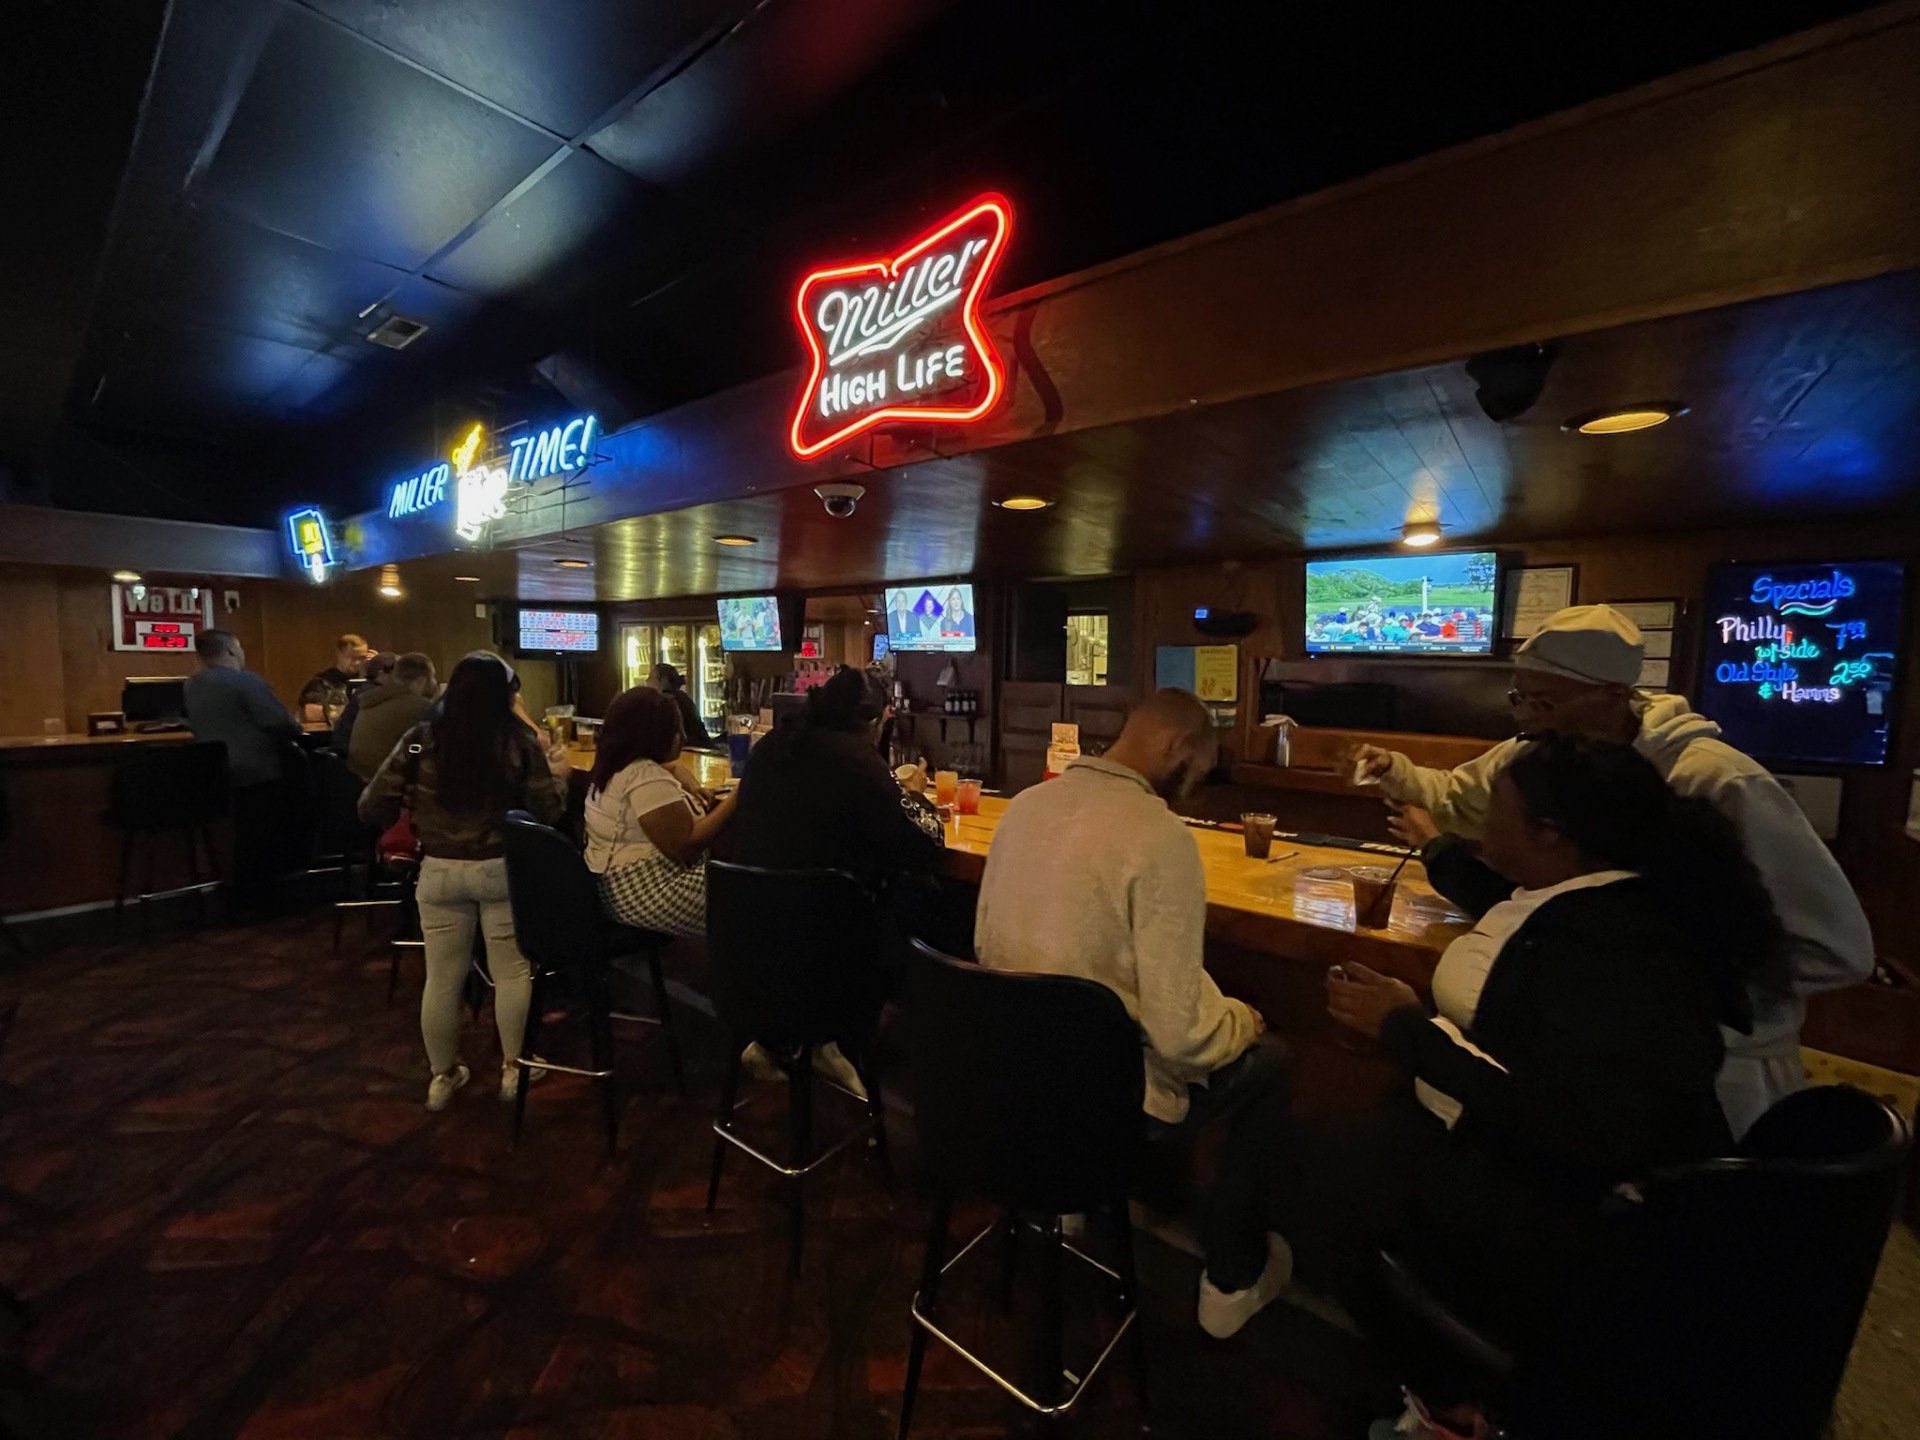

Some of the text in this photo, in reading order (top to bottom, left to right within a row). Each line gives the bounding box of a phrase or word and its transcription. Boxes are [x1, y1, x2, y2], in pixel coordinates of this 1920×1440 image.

[817, 238, 988, 356] Miller
[820, 345, 966, 417] HIGH LIFE
[389, 463, 450, 519] MILLER
[509, 415, 597, 482] TIME!
[1750, 571, 1855, 610] Specials
[1716, 615, 1787, 653] Philly
[1716, 662, 1750, 683] Old
[1751, 661, 1799, 692] Style
